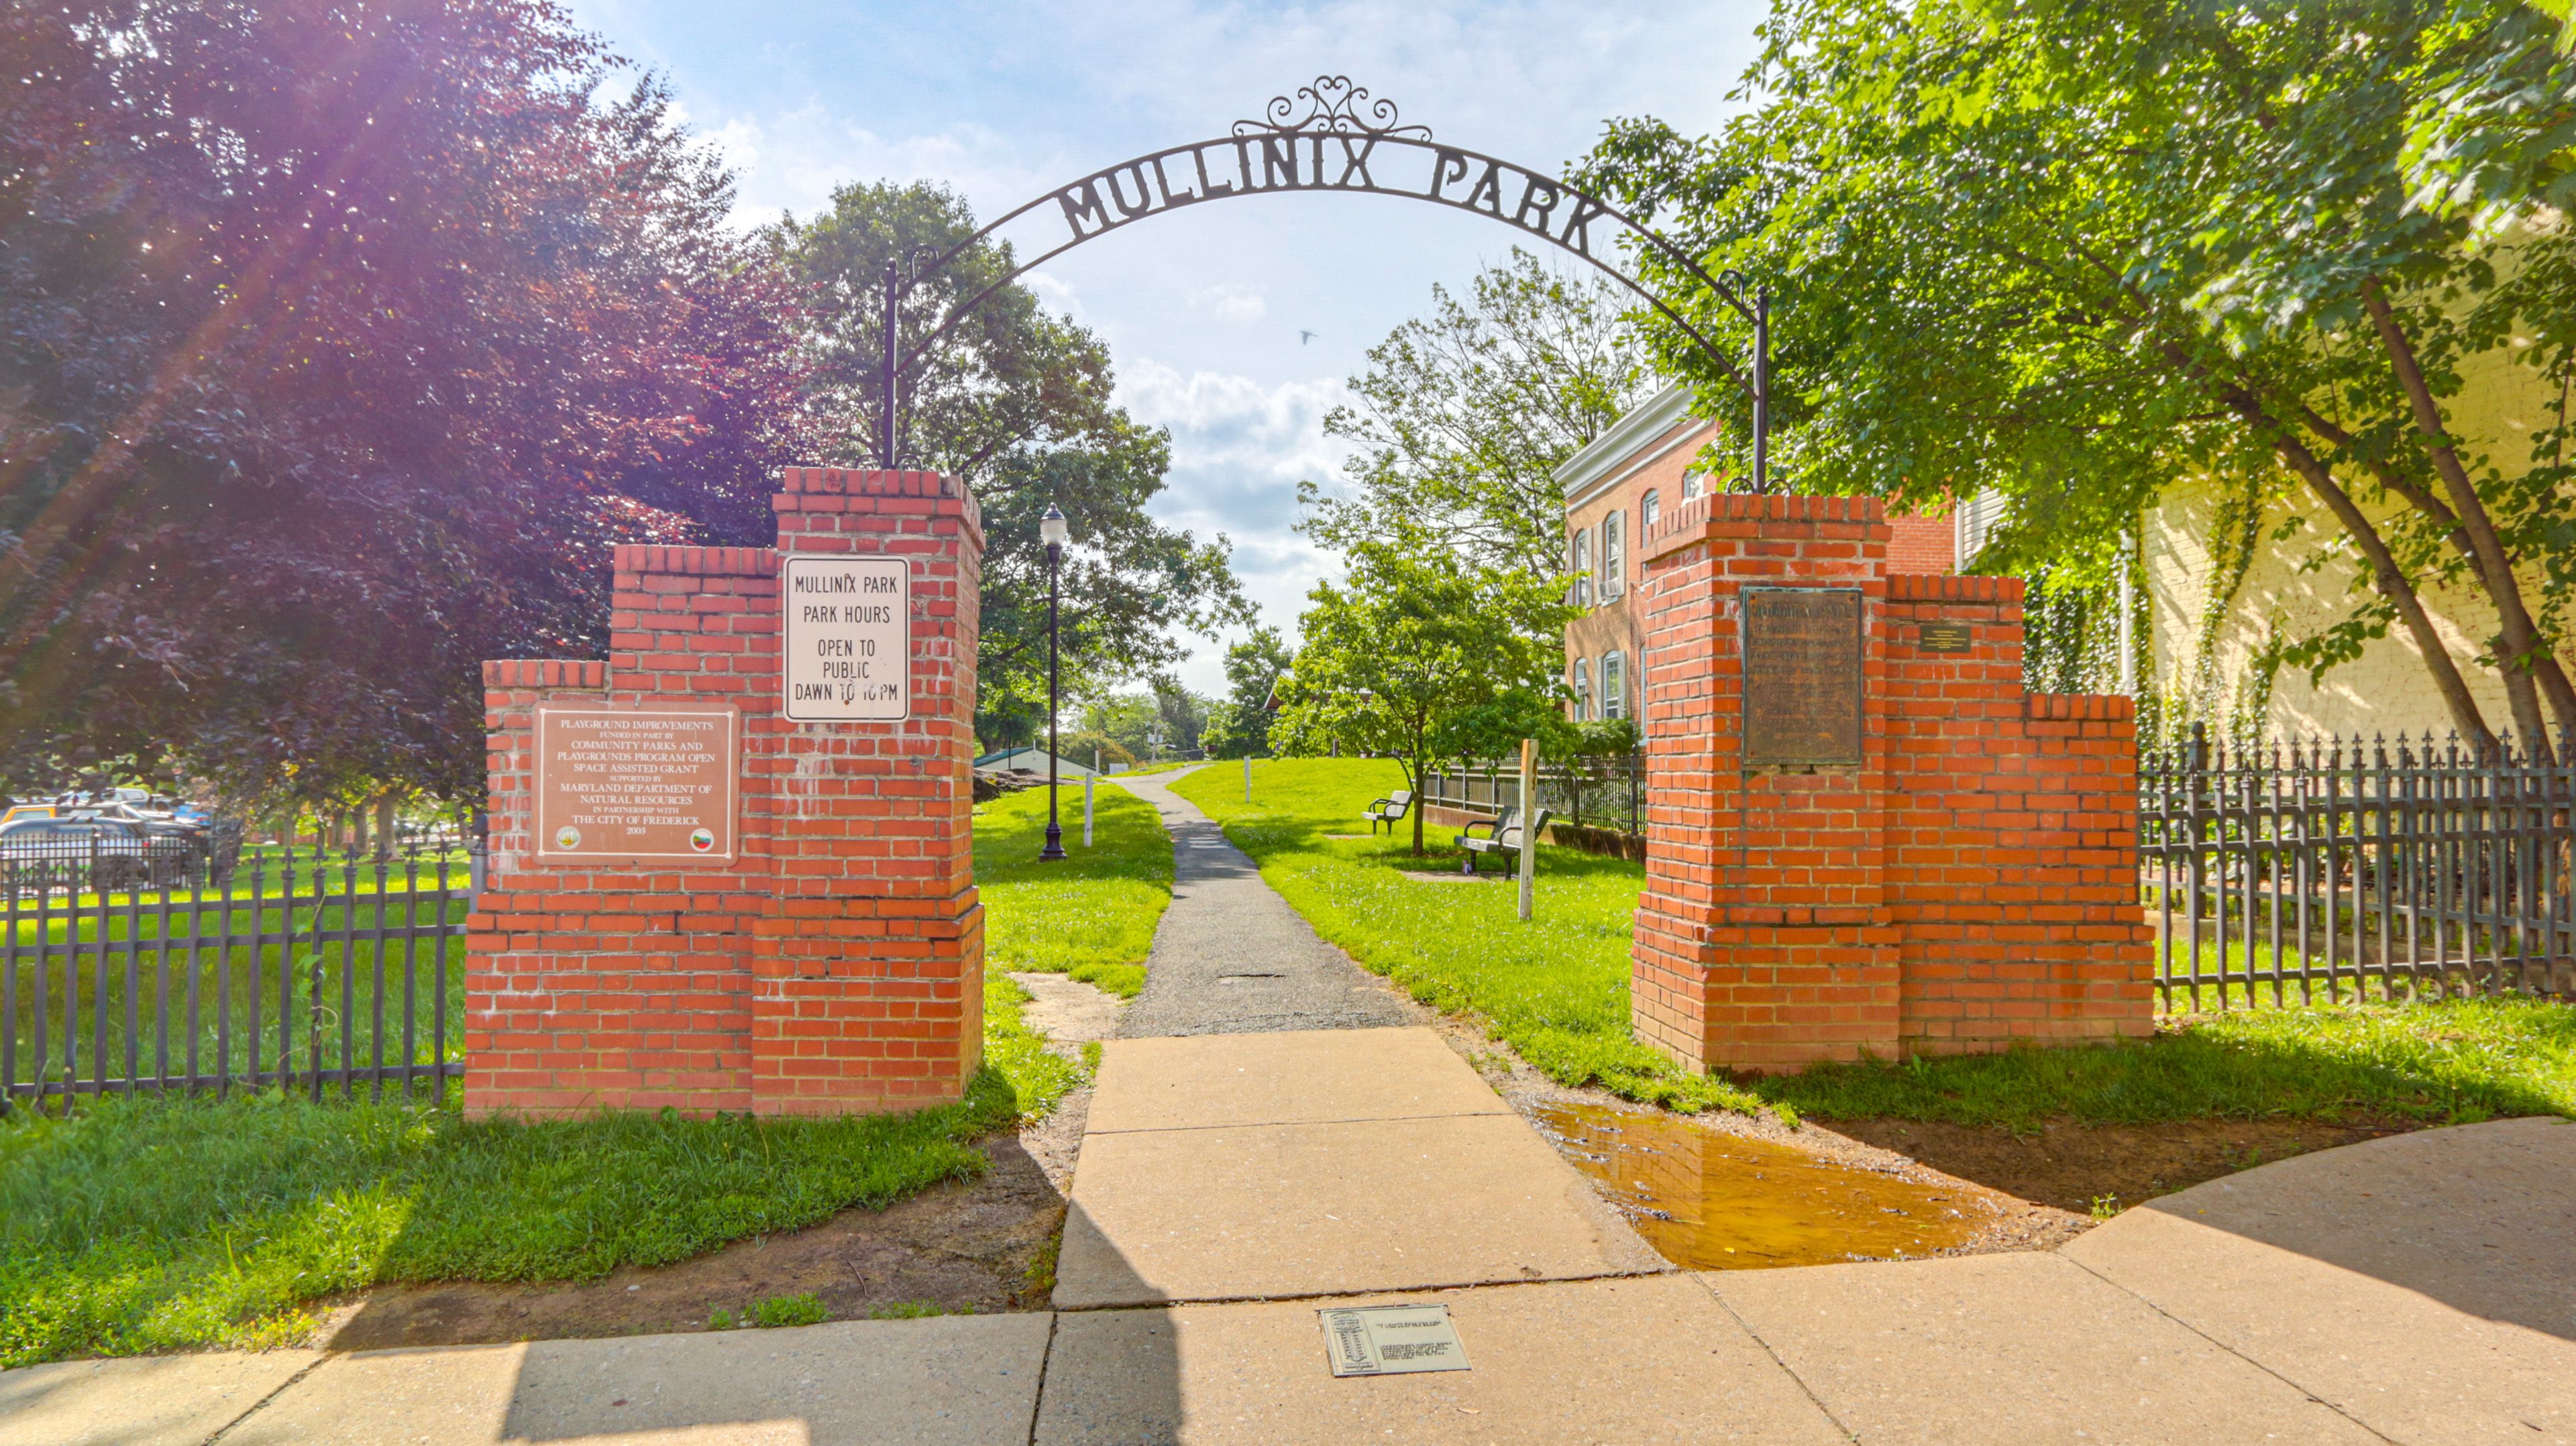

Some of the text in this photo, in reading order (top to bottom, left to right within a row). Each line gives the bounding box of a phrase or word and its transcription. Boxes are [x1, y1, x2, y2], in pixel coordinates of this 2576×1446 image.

[1055, 135, 1604, 258] MULLINIX PARK
[795, 576, 898, 593] MULLINIX PARK
[804, 606, 890, 623] PARK HOURS
[818, 640, 875, 657] OPEN TO
[823, 662, 869, 678] PUBLIC
[796, 683, 833, 700] DAWN
[880, 684, 897, 700] PM
[560, 720, 714, 730] PLAYGROUND IMPROVEMENTS
[572, 740, 703, 750] COMMUNITY PARKS AND
[557, 752, 715, 763] PLAYGROUNDS PROGRAM OPEN
[574, 763, 699, 773] SPACE ASSISTED GRANT
[560, 783, 712, 793] MARYLAND DEPARTMENT OF
[580, 795, 692, 805] NATURAL RESOURCES
[572, 815, 700, 825] THE CITY OF FREDERICK
